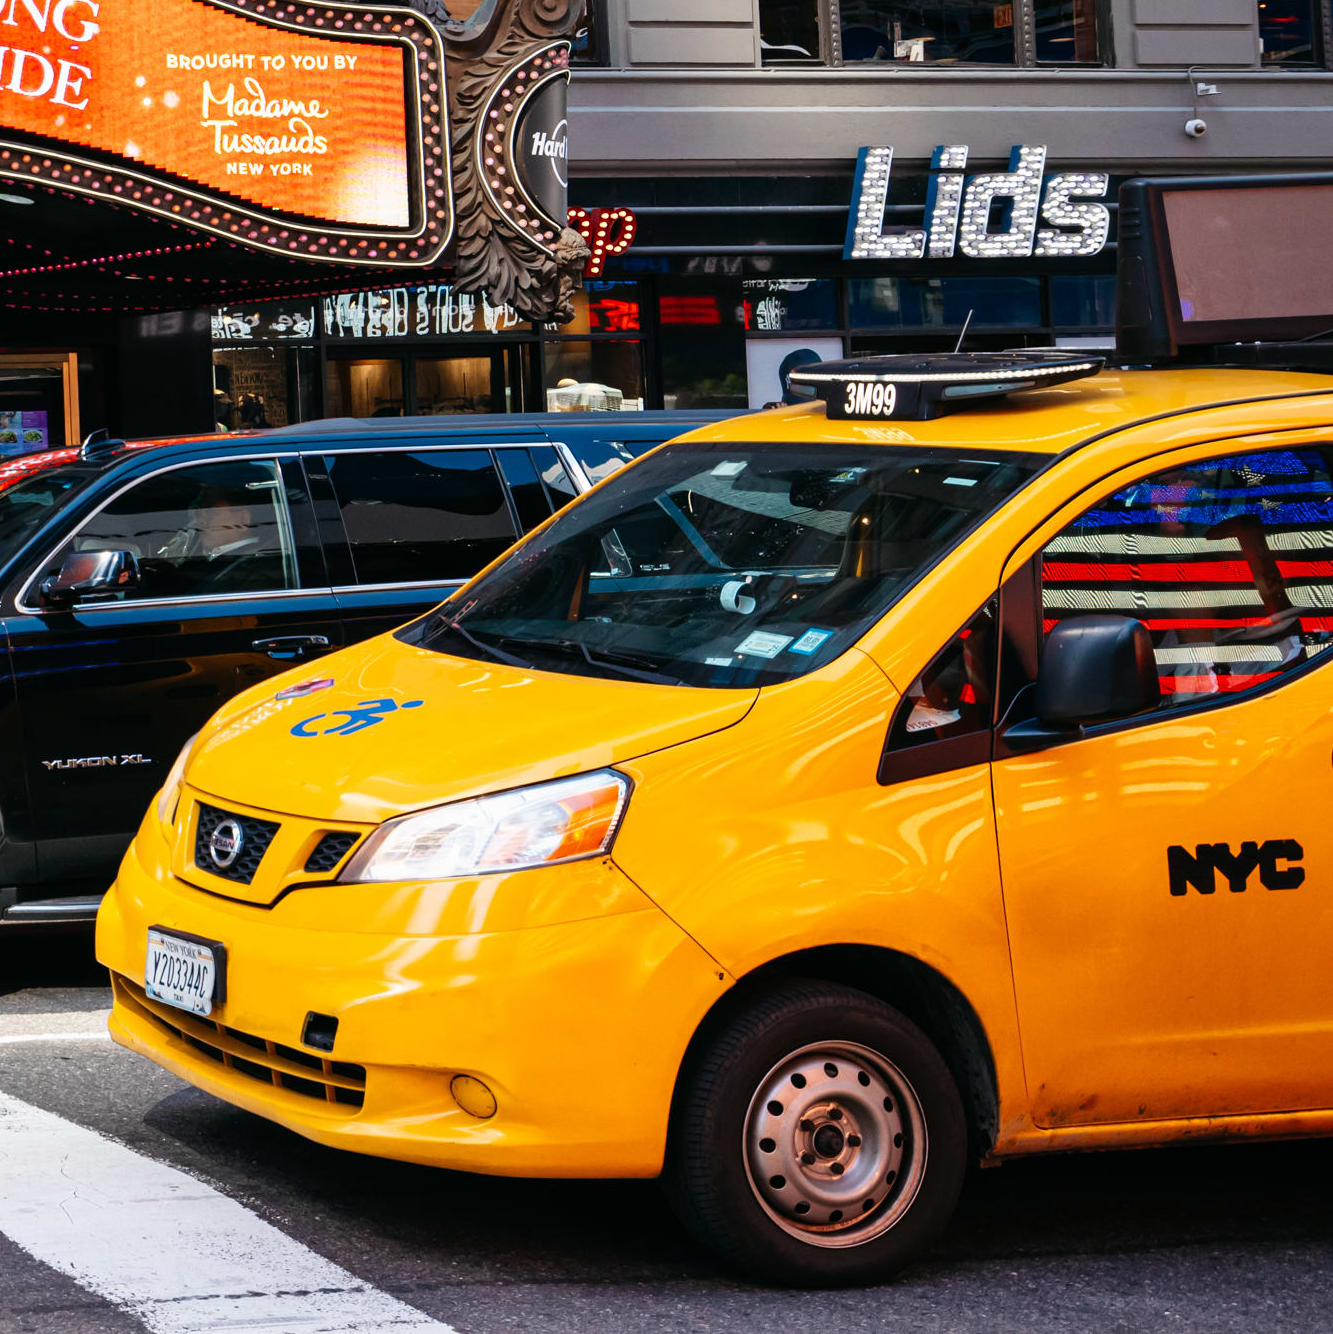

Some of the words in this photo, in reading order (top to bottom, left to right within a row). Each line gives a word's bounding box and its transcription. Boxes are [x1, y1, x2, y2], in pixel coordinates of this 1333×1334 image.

[166, 53, 255, 70] BROUGHT
[261, 55, 285, 70] TO
[291, 54, 328, 70] YOU
[334, 55, 357, 70] BY
[202, 77, 329, 119] Madame
[200, 117, 328, 154] Tussauds
[531, 132, 565, 158] Hard
[227, 163, 264, 175] NEW
[269, 163, 313, 176] YORK
[843, 144, 1110, 259] Lids
[844, 382, 896, 415] 3M99
[41, 755, 116, 770] YUKON
[120, 753, 152, 765] XL
[1167, 839, 1305, 896] NYC
[165, 941, 179, 953] NEW
[180, 944, 198, 959] YORK
[154, 951, 209, 998] Y203344C
[173, 993, 184, 1002] TAXI
